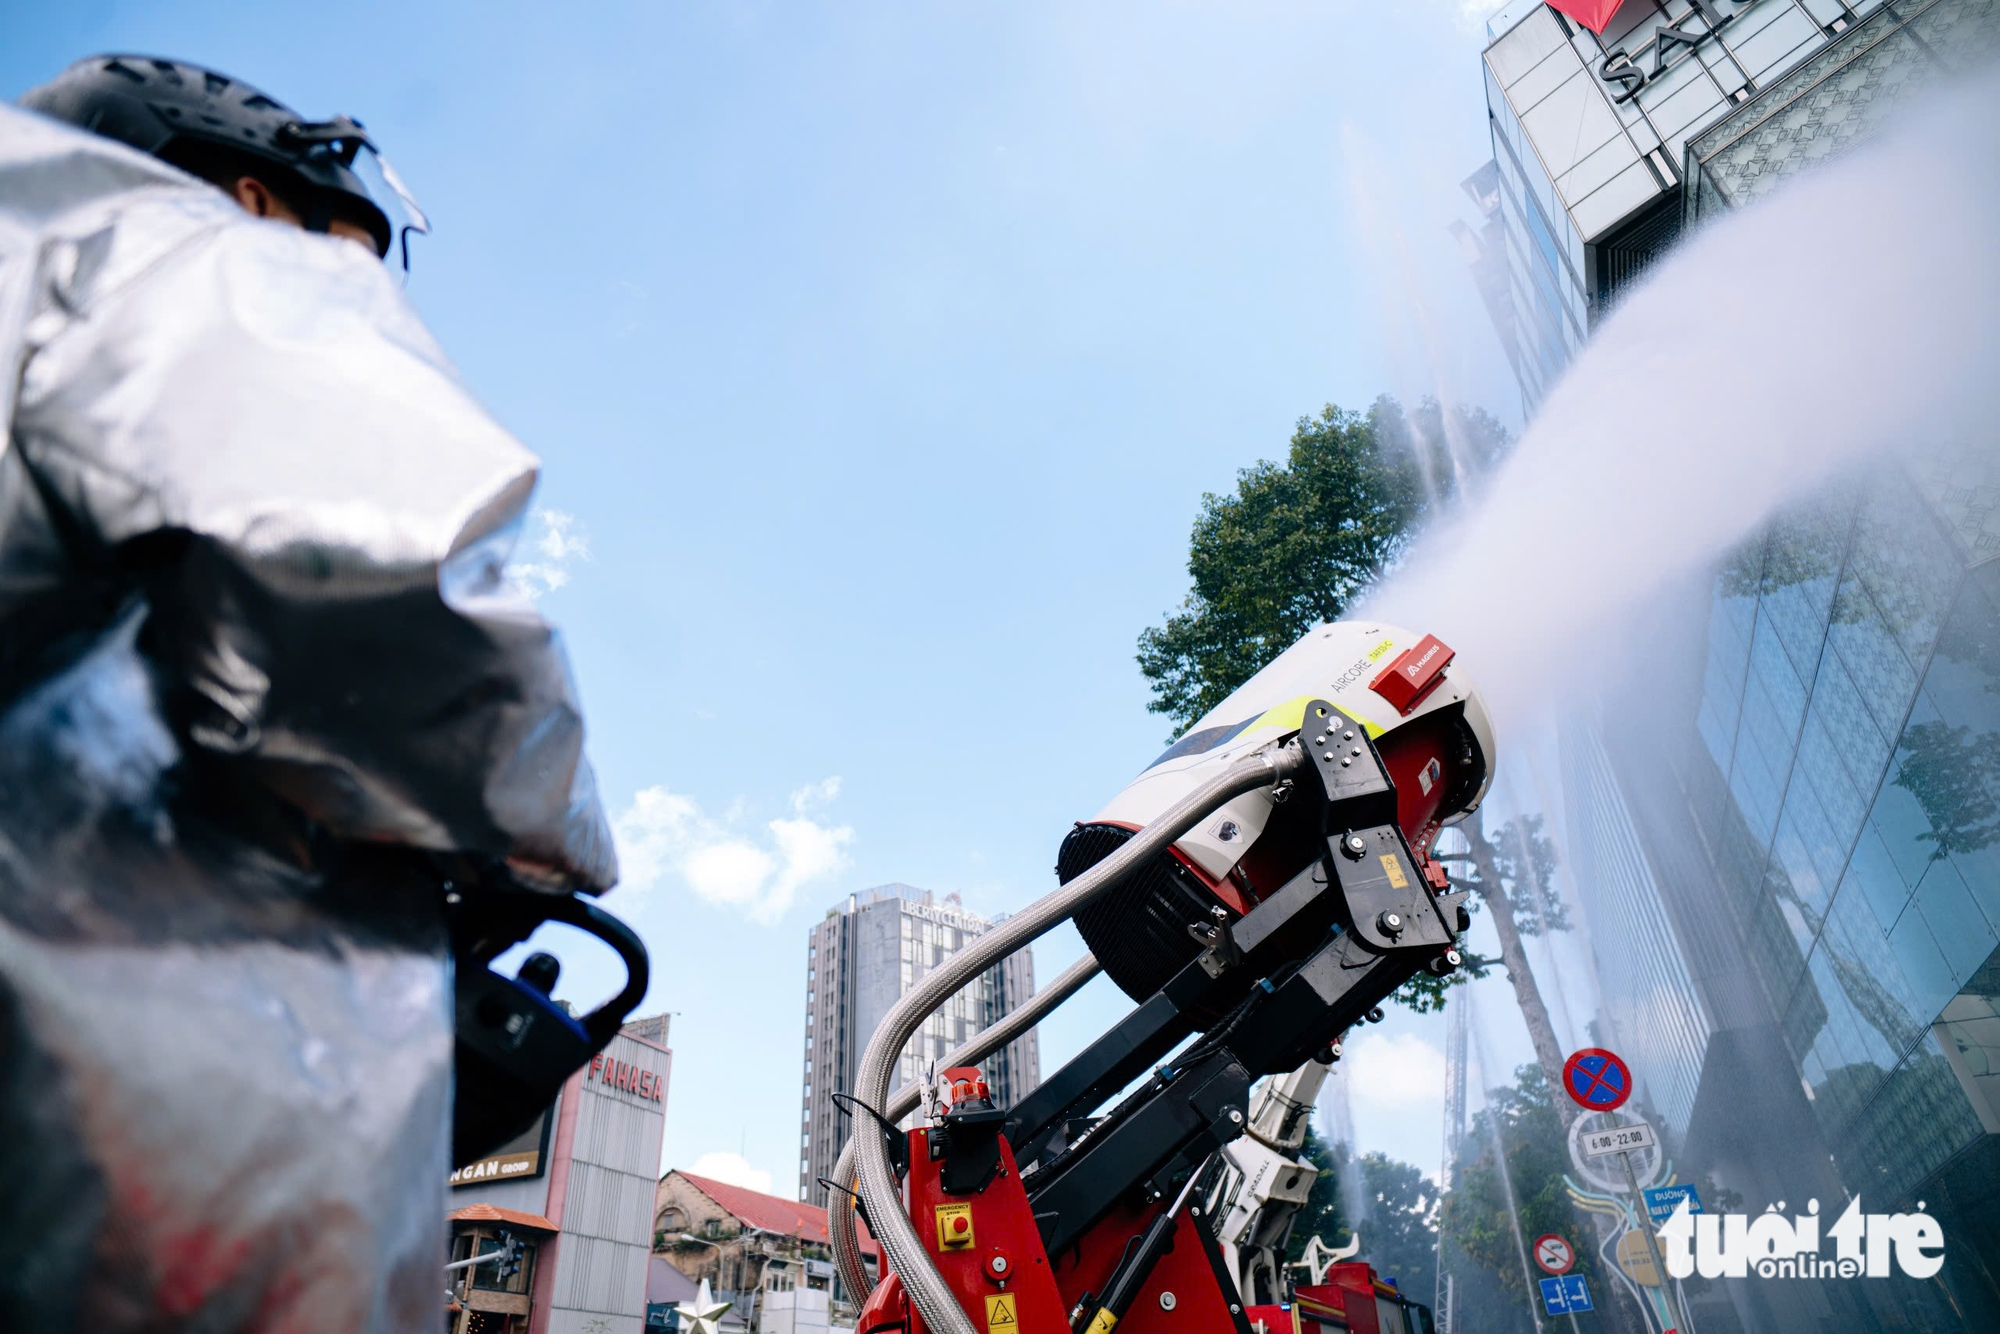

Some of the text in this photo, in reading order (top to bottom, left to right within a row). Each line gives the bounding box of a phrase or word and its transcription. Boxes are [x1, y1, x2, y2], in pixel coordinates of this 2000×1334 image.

[1416, 644, 1440, 668] MAGIRUS
[1331, 659, 1372, 693] AIRCORE
[900, 899, 941, 924] LIBERTY
[588, 1053, 664, 1102] FAHASA
[501, 1161, 529, 1174] GROUP
